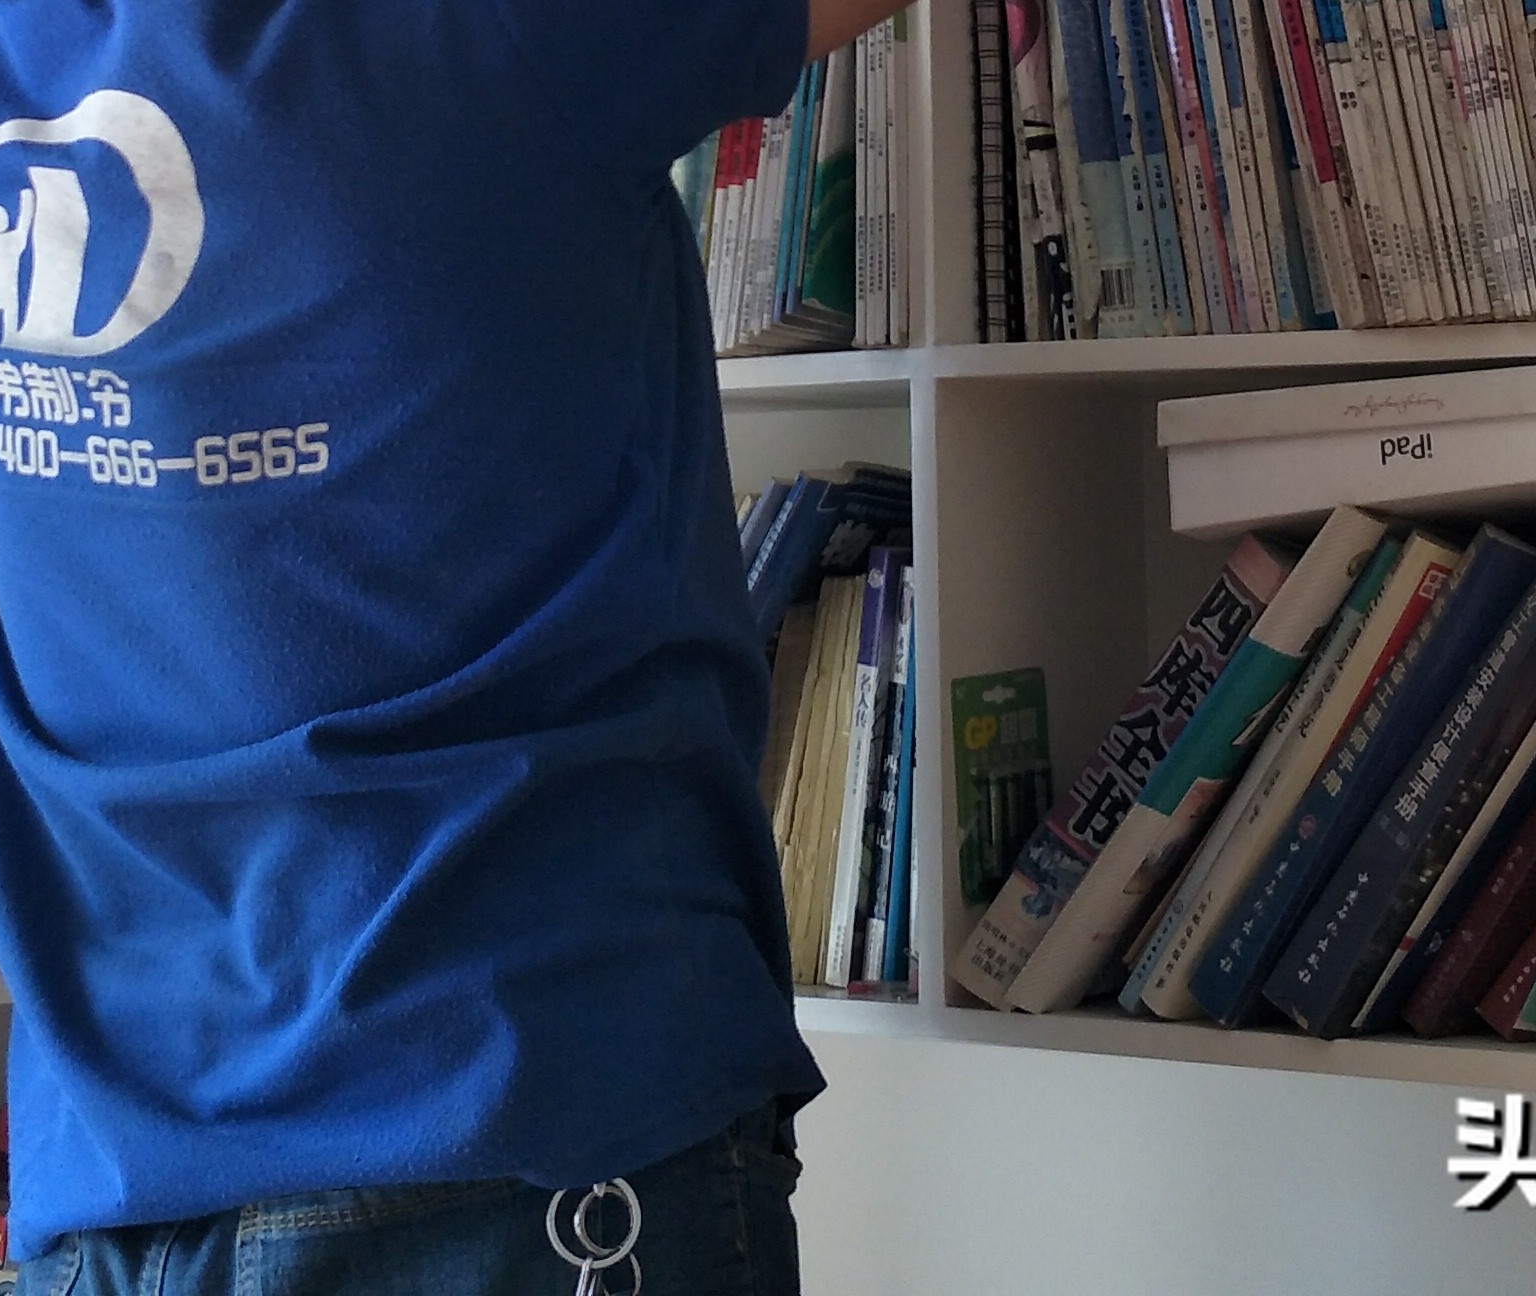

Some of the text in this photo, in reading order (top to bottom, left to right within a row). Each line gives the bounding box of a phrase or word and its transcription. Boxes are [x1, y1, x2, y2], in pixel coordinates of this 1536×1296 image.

[1380, 433, 1434, 465] iPad
[854, 672, 872, 727] 名人传
[1066, 576, 1257, 851] 四库全书
[963, 713, 996, 750] GP
